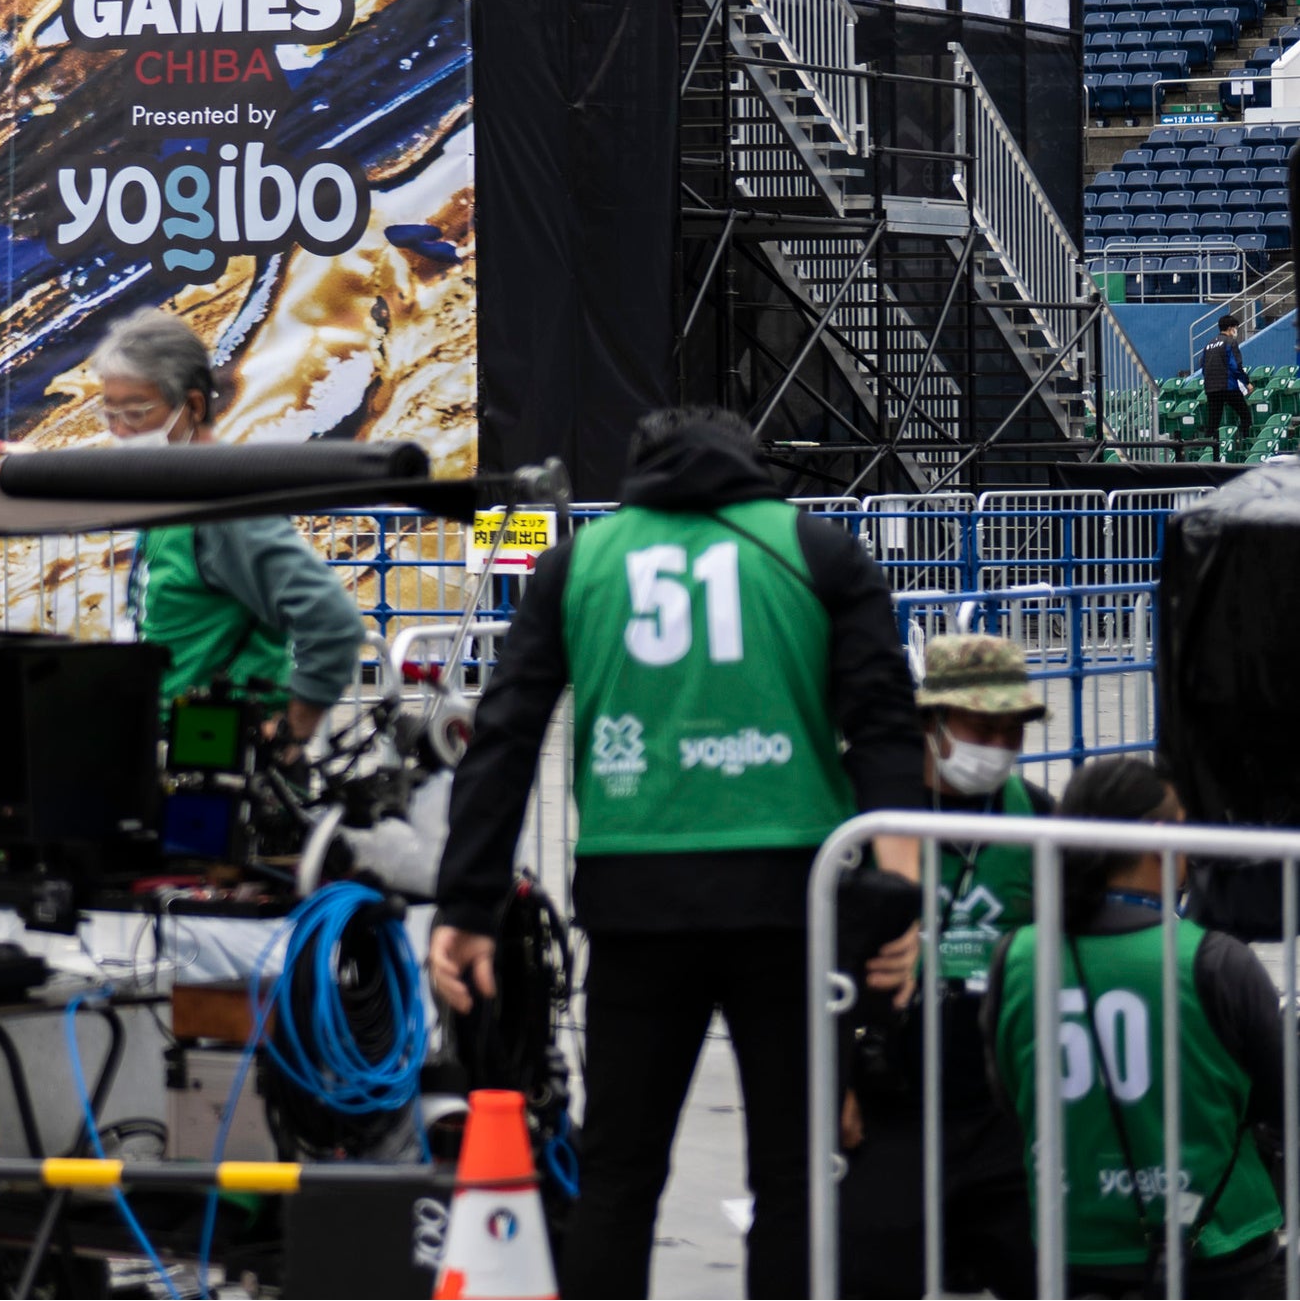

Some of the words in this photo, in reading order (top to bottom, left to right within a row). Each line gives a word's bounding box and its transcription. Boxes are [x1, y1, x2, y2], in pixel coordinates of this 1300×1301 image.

[135, 48, 274, 86] CHIBA
[131, 104, 239, 127] Presented
[247, 105, 277, 130] by
[1174, 115, 1189, 124] 137
[1190, 115, 1204, 124] 141
[57, 141, 358, 272] yogibo
[624, 540, 745, 667] 51
[679, 726, 793, 777] yogibo
